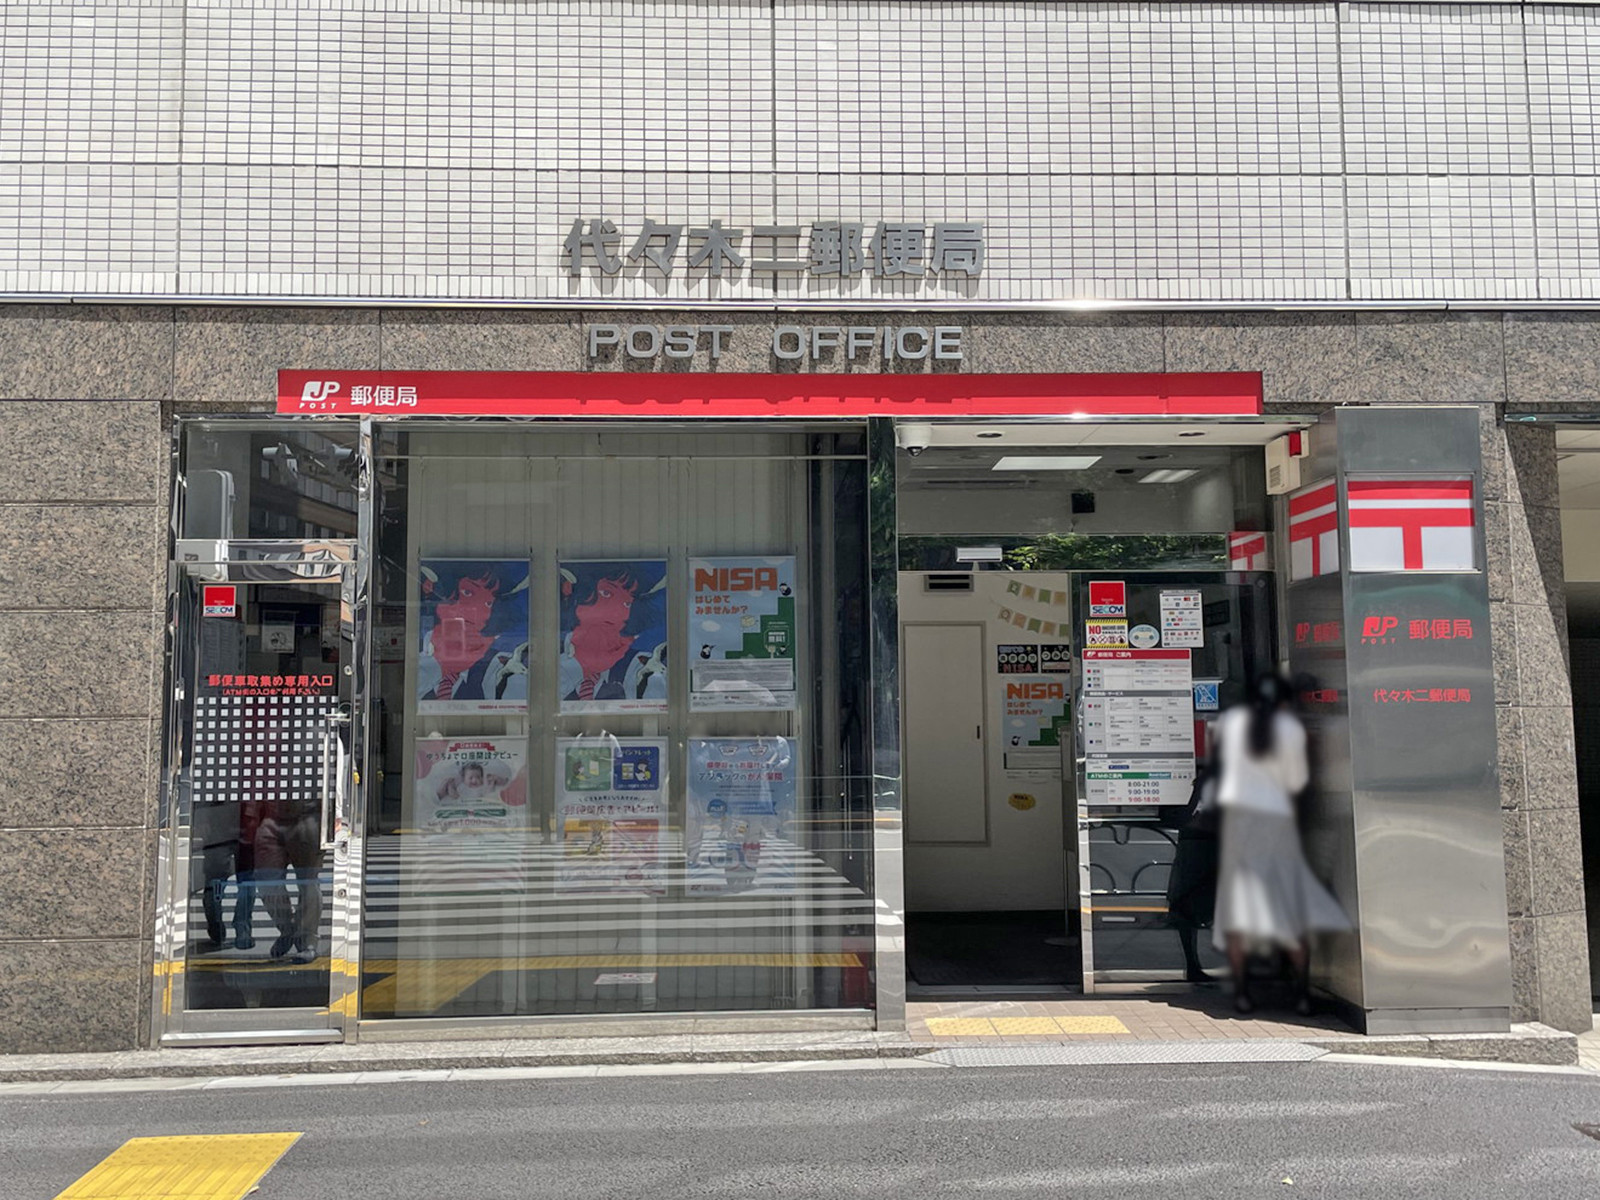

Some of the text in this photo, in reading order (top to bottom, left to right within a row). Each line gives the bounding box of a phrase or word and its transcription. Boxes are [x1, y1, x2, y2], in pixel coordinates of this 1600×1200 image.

[564, 218, 985, 277] 代々木二郵便局
[589, 325, 963, 360] POST OFFICE
[350, 385, 418, 407] 郵便局
[695, 568, 778, 591] NISA
[695, 595, 731, 604] はじめて
[1092, 605, 1124, 614] SECOM
[1088, 625, 1102, 634] NO
[1409, 619, 1473, 640] 郵便局
[1003, 663, 1033, 672] NISA
[208, 674, 333, 687] 郵便車取集め専用入口
[1007, 683, 1063, 699] NISA
[1373, 688, 1472, 703] 代々木二郵便局
